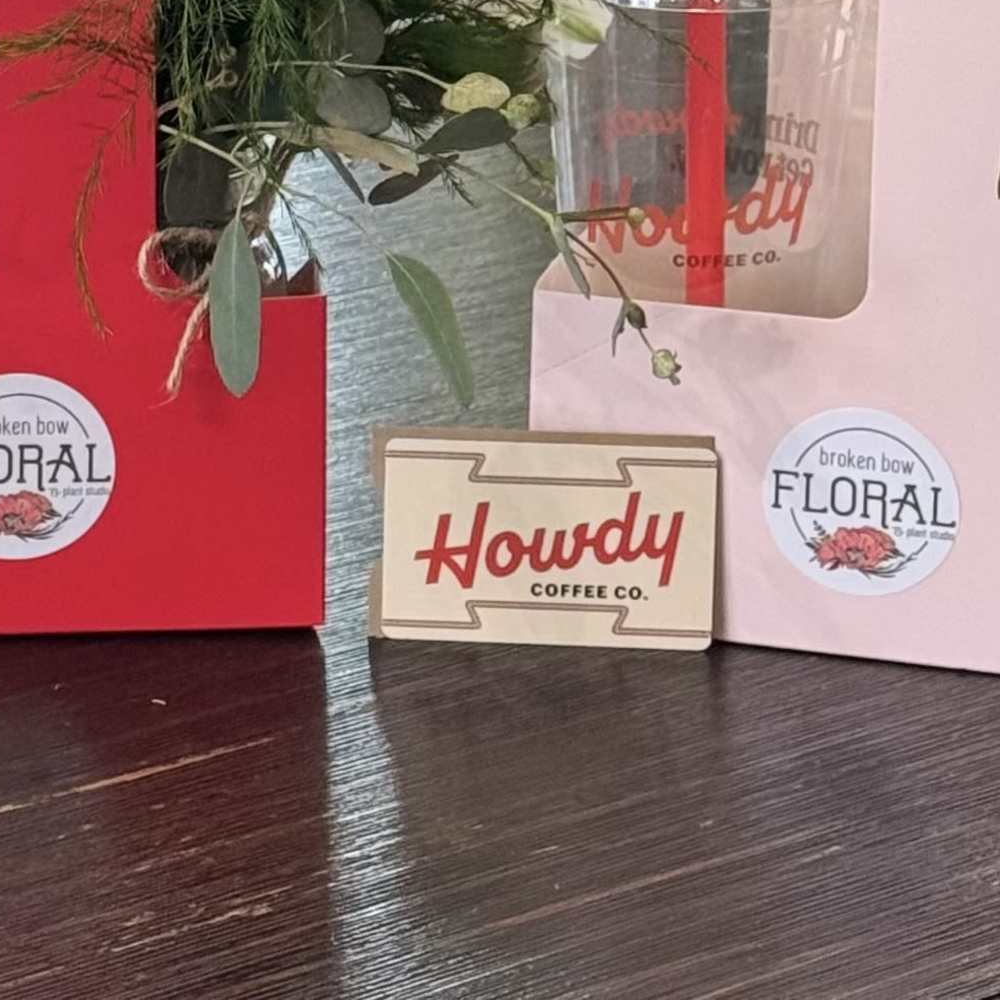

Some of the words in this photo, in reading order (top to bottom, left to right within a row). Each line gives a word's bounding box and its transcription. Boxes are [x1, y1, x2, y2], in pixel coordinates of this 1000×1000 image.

[672, 253, 747, 268] COFFEE
[752, 249, 781, 265] CO.
[36, 416, 69, 435] bow
[819, 445, 876, 471] broken
[881, 452, 915, 475] bow
[771, 469, 956, 529] FLORAL
[414, 491, 684, 589] Howdy
[530, 583, 607, 599] COFFEE
[614, 585, 649, 601] CO.
